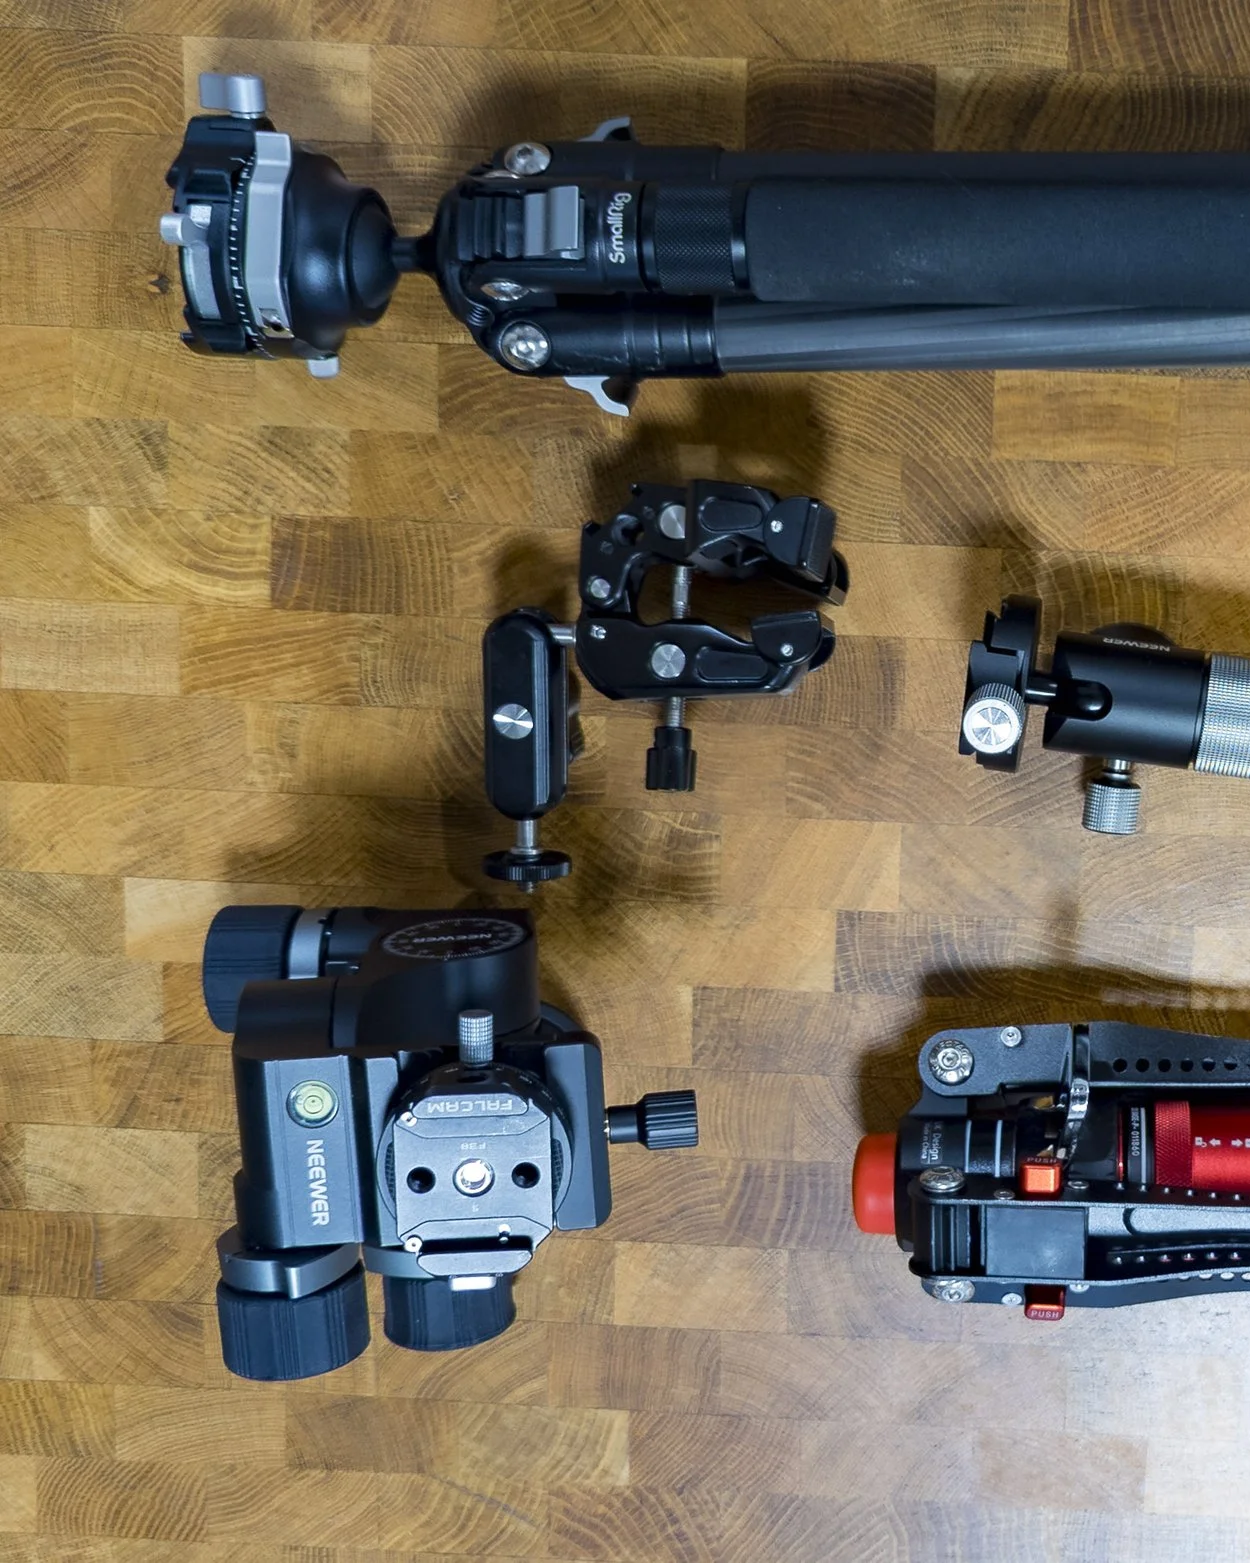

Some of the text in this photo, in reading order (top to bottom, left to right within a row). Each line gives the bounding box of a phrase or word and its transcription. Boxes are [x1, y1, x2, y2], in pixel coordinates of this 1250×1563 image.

[607, 192, 632, 264] SmallRig
[1103, 637, 1170, 652] NEEWER
[427, 1099, 513, 1113] FALCAM
[306, 1139, 330, 1227] NEEWER
[1031, 1310, 1060, 1319] PUSH
